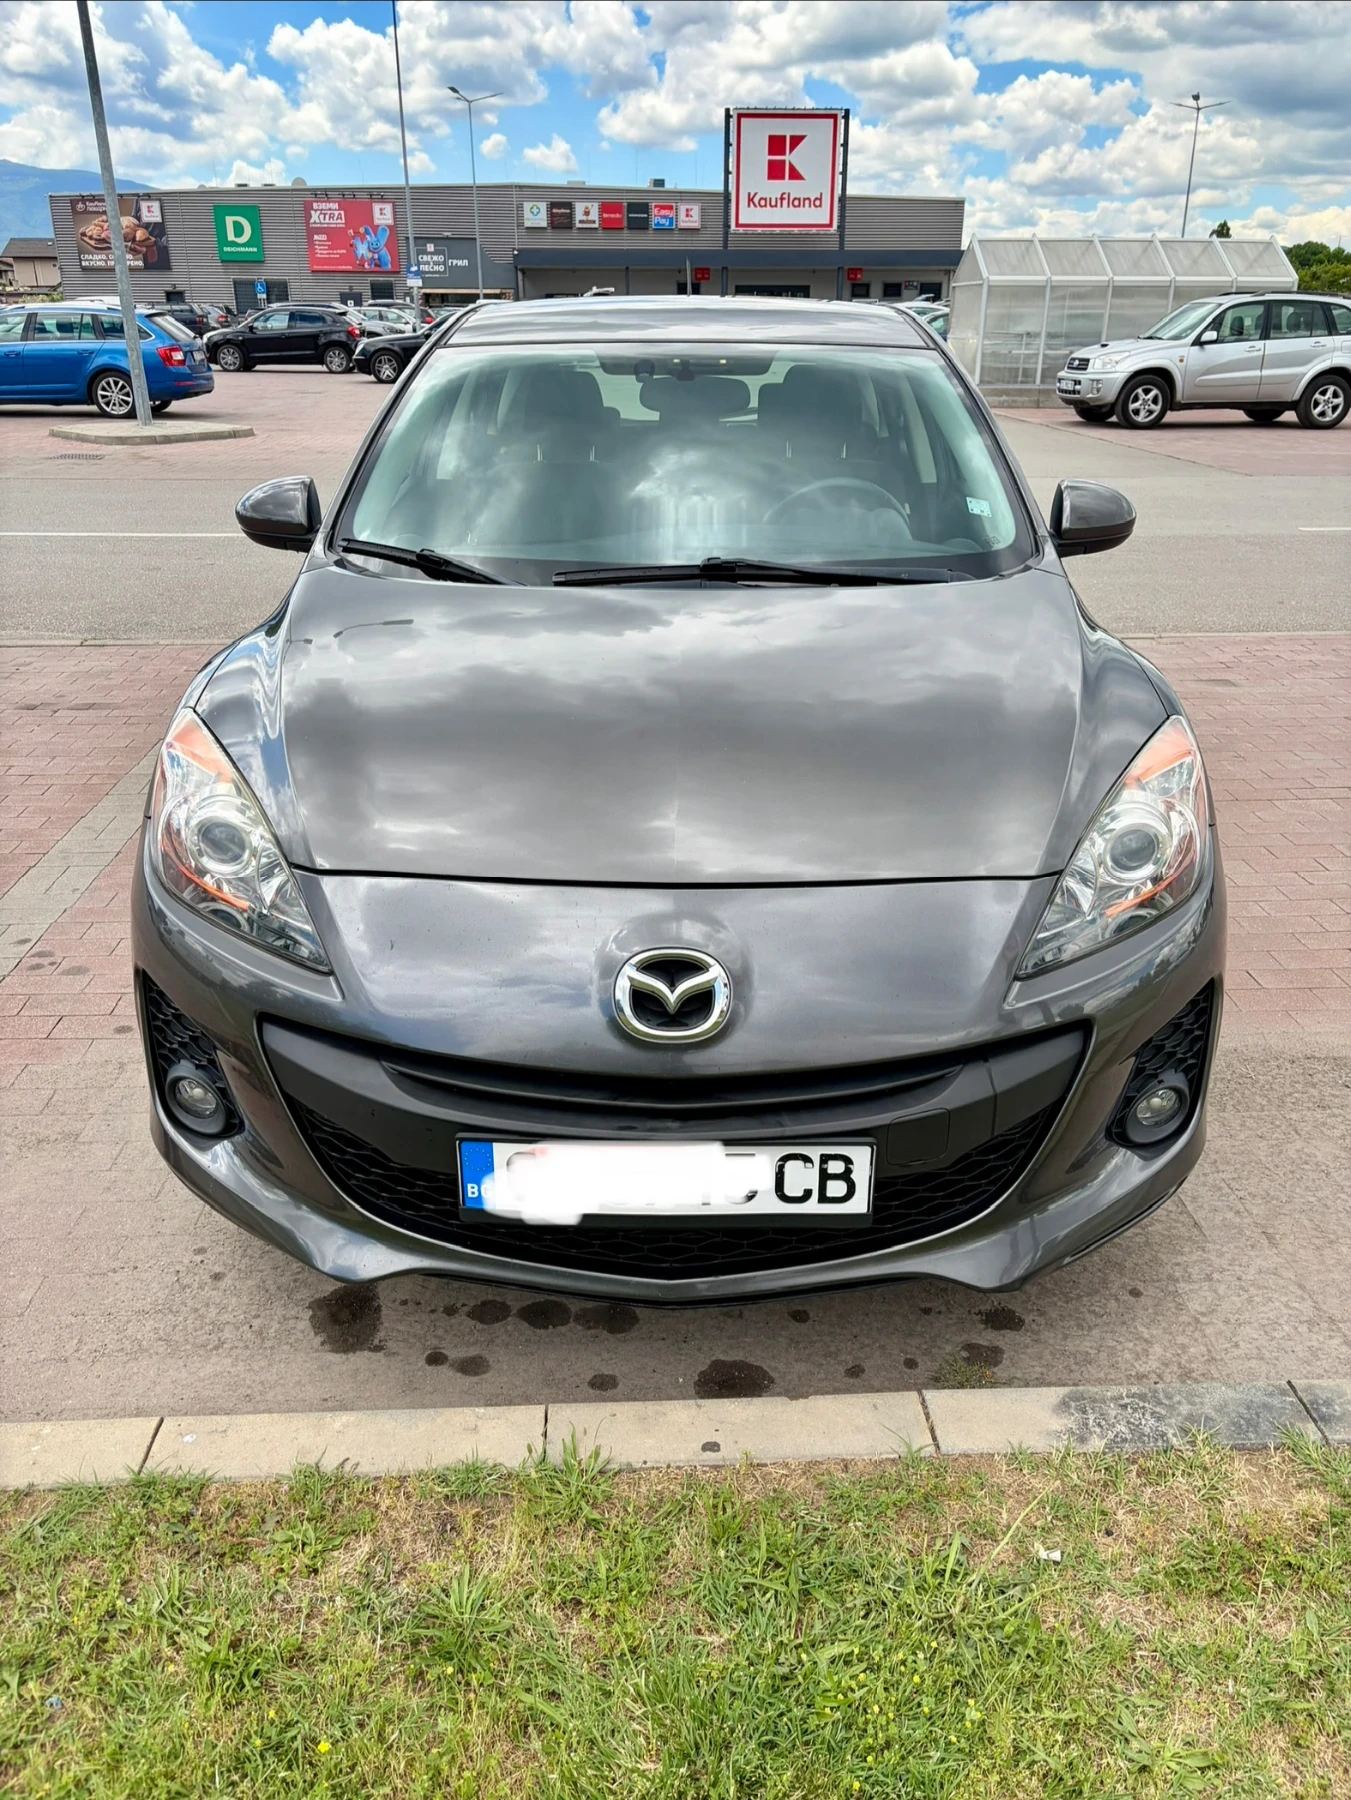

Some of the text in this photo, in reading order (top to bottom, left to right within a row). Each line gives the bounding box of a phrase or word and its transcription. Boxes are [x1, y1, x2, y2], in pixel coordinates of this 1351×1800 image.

[747, 191, 823, 208] Kaufland
[312, 202, 339, 210] ВЗЕМИ
[654, 207, 673, 216] Easy
[310, 210, 345, 223] XTRA
[654, 217, 670, 226] Pay
[225, 215, 252, 244] D
[418, 254, 445, 262] СВЕЖО
[448, 259, 469, 267] ГРИЛ
[774, 1152, 857, 1204] CB
